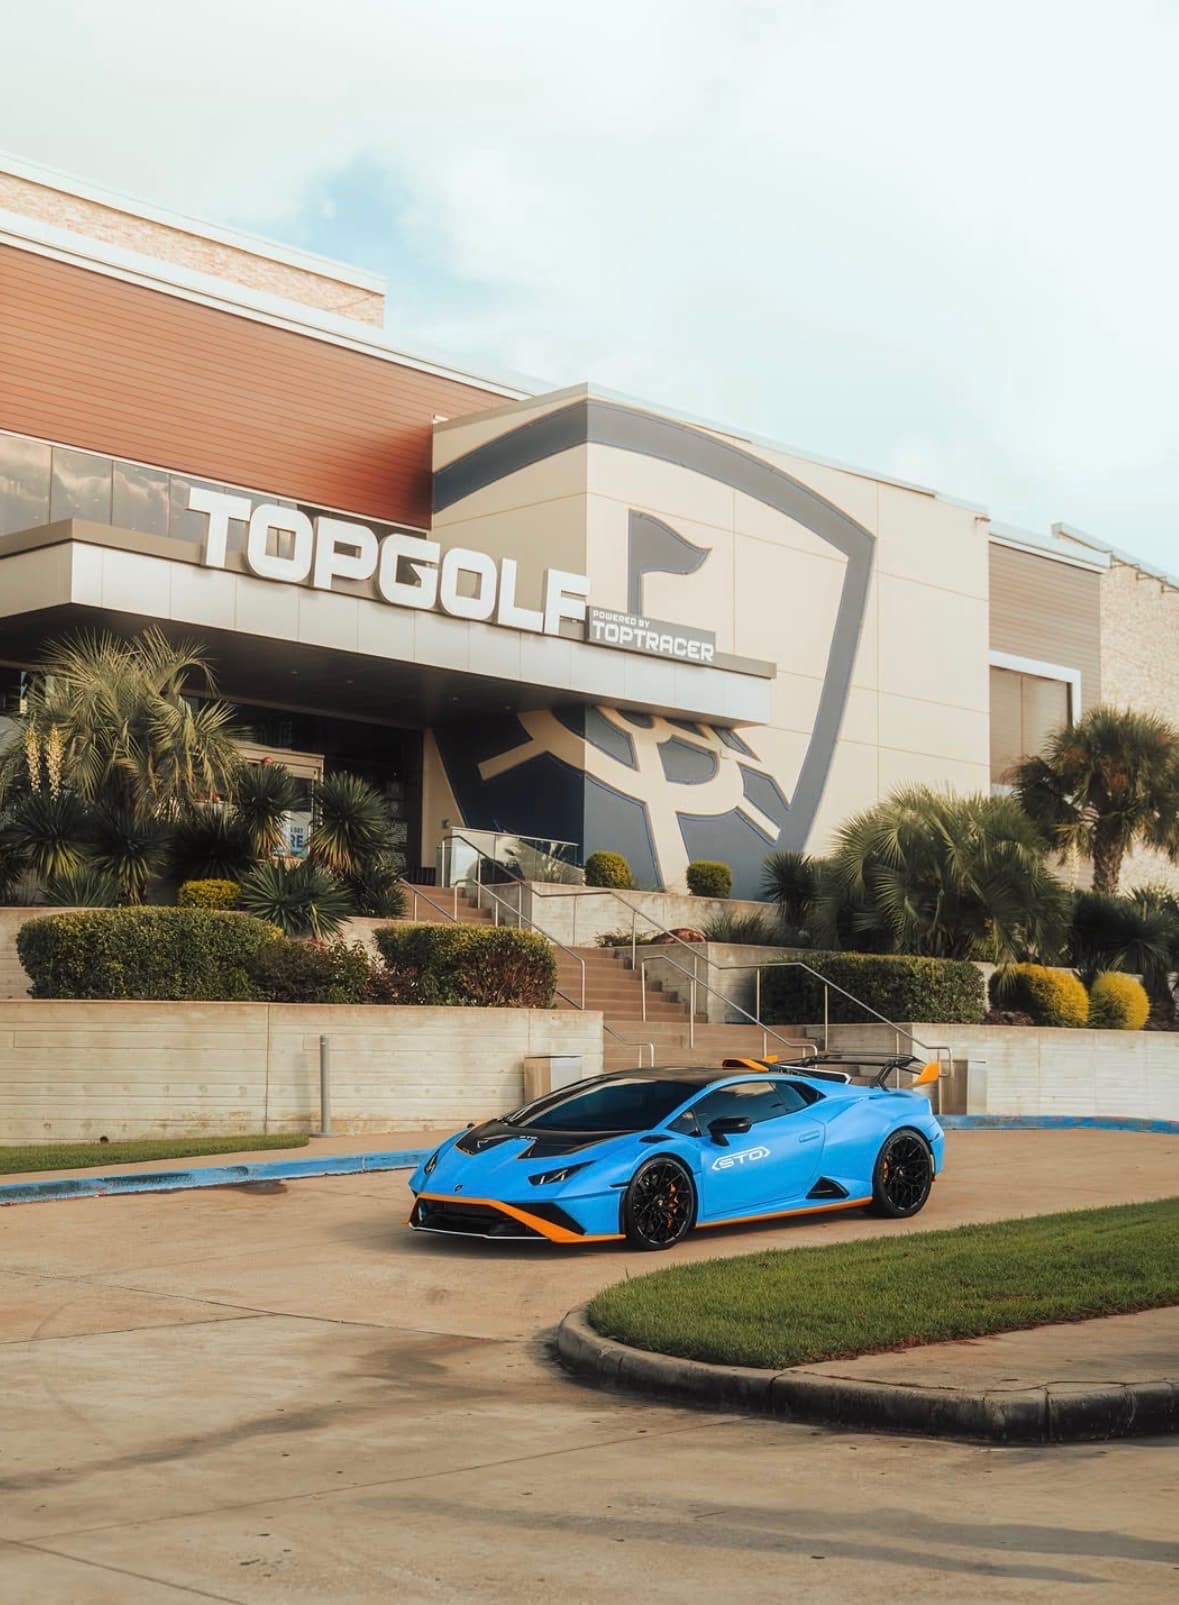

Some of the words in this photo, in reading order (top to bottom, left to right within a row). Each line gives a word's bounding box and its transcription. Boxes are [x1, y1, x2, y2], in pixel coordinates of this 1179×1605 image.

[187, 486, 591, 635] TOPGOLF
[593, 610, 637, 626] POWERED
[639, 619, 651, 628] BY
[592, 620, 714, 662] TOPTRACER
[717, 1148, 765, 1169] STO
